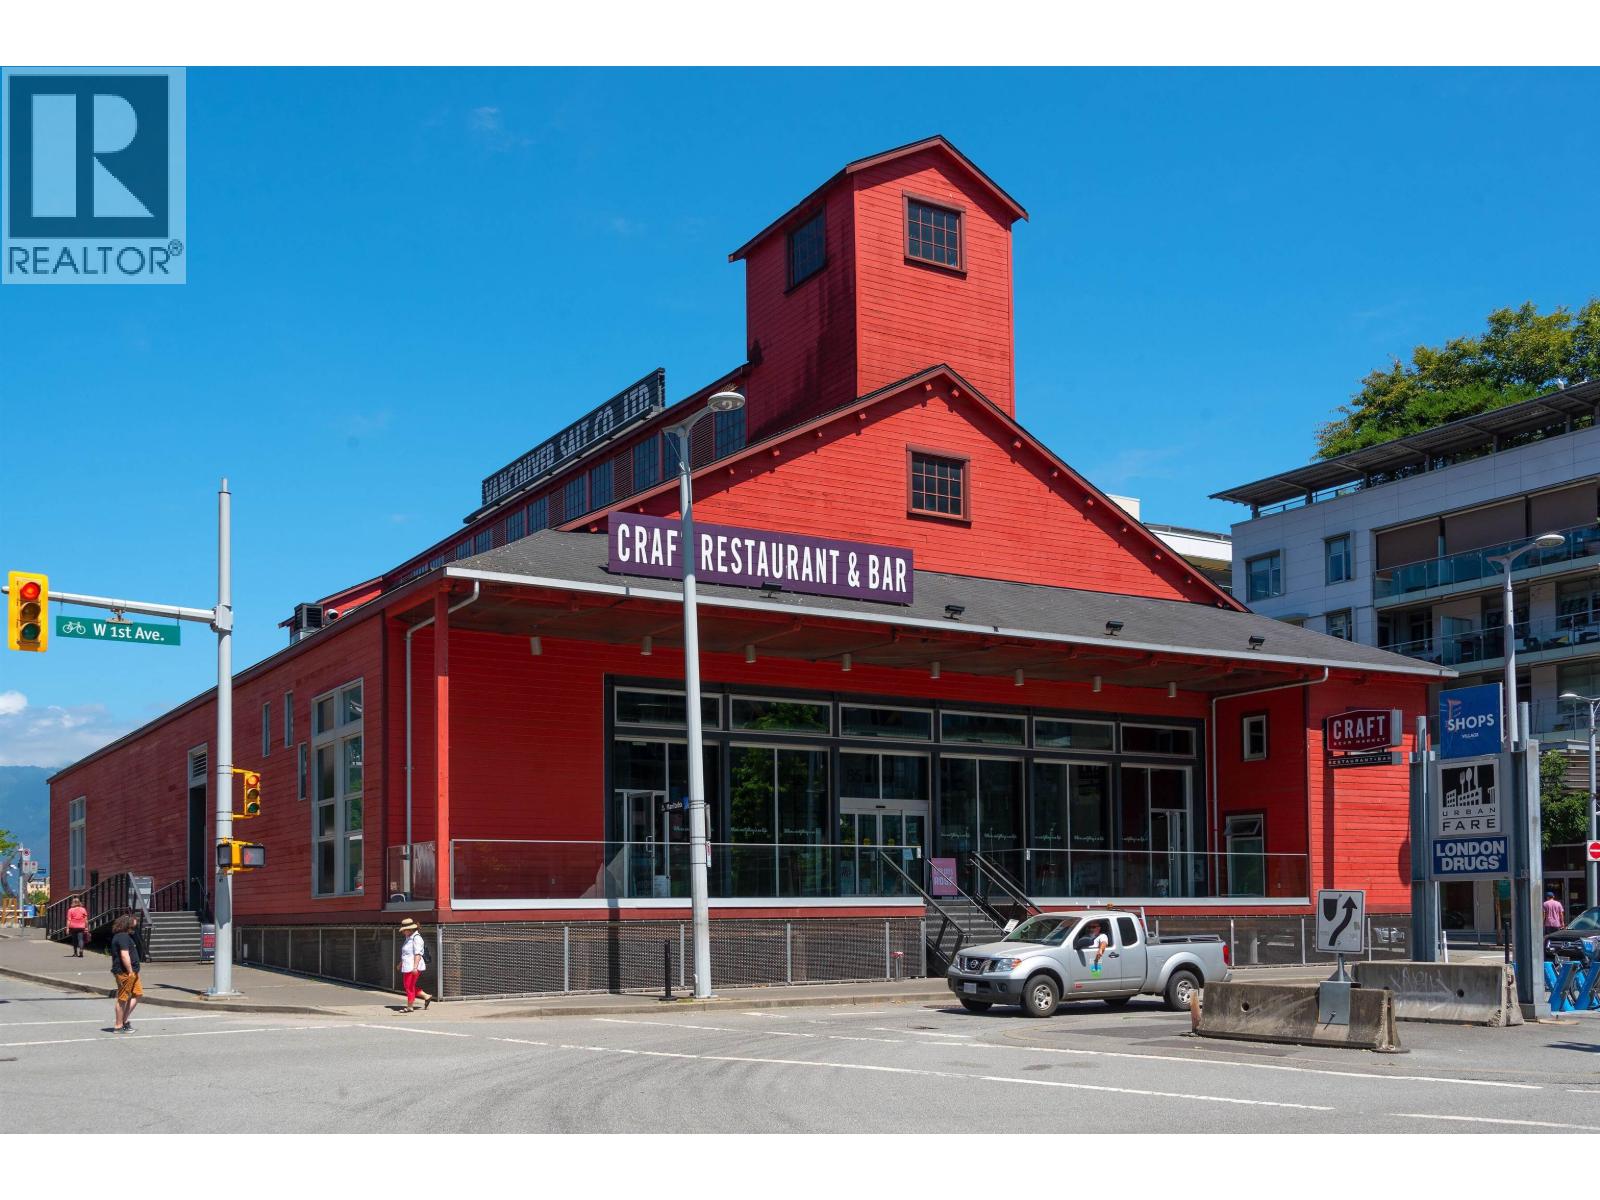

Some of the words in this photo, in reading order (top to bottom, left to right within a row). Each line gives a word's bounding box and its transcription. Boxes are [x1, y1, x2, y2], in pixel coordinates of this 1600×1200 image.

[617, 523, 684, 567] CRAF
[701, 533, 840, 585] RESTAURANT
[848, 551, 860, 588] &
[868, 554, 907, 593] BAR
[93, 623, 106, 637] W
[110, 626, 132, 639] 1st
[135, 626, 165, 641] Ave.
[1333, 716, 1385, 739] CRAFT
[1448, 713, 1495, 731] SHOPS
[1442, 807, 1496, 817] URBAN
[1442, 818, 1496, 832] FARE
[1436, 840, 1505, 857] LONDON
[1441, 855, 1500, 872] DRUGS
